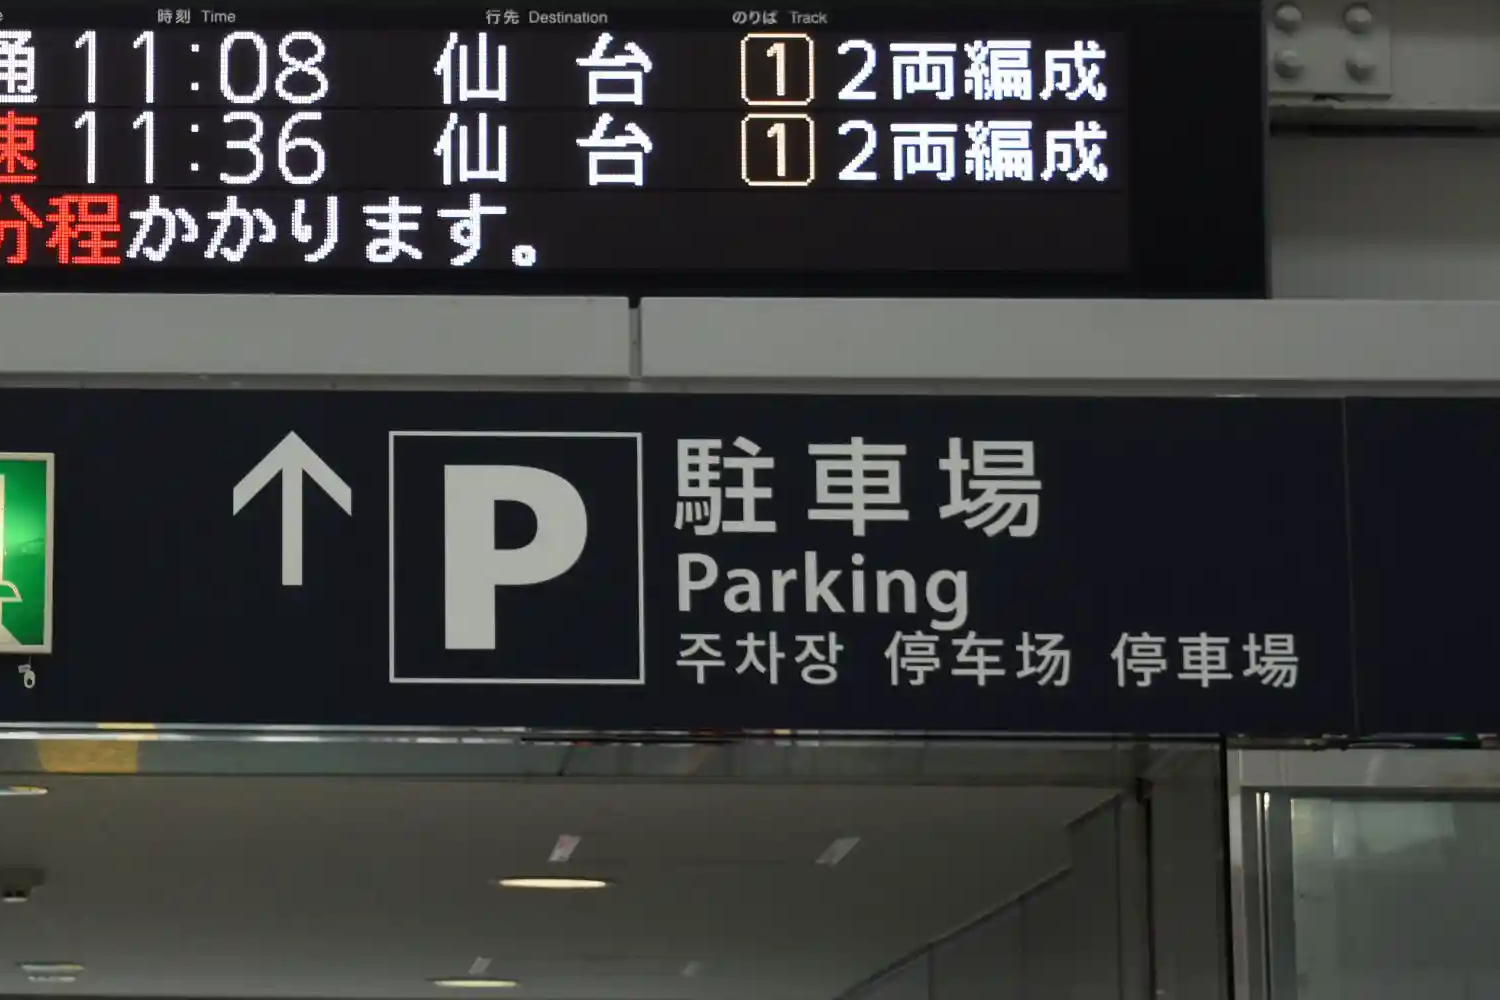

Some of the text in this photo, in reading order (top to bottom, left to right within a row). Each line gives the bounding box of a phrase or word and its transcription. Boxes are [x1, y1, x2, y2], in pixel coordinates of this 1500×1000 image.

[158, 9, 235, 23] 時刻 Time
[486, 10, 607, 24] 行先 Destination
[732, 11, 827, 24] のりば Track
[75, 31, 328, 104] 11:08
[434, 32, 652, 105] 仙台
[767, 43, 785, 97] 1
[838, 40, 1107, 101] 2両編成
[75, 111, 325, 184] 11:36
[433, 112, 653, 186] 仙台
[767, 123, 785, 177] 1
[839, 120, 1108, 182] 2両編成
[674, 436, 1041, 537] 駐車場
[444, 464, 588, 650] P
[678, 552, 970, 630] Parking
[676, 631, 1298, 687] 주차장 停车场 停車場
